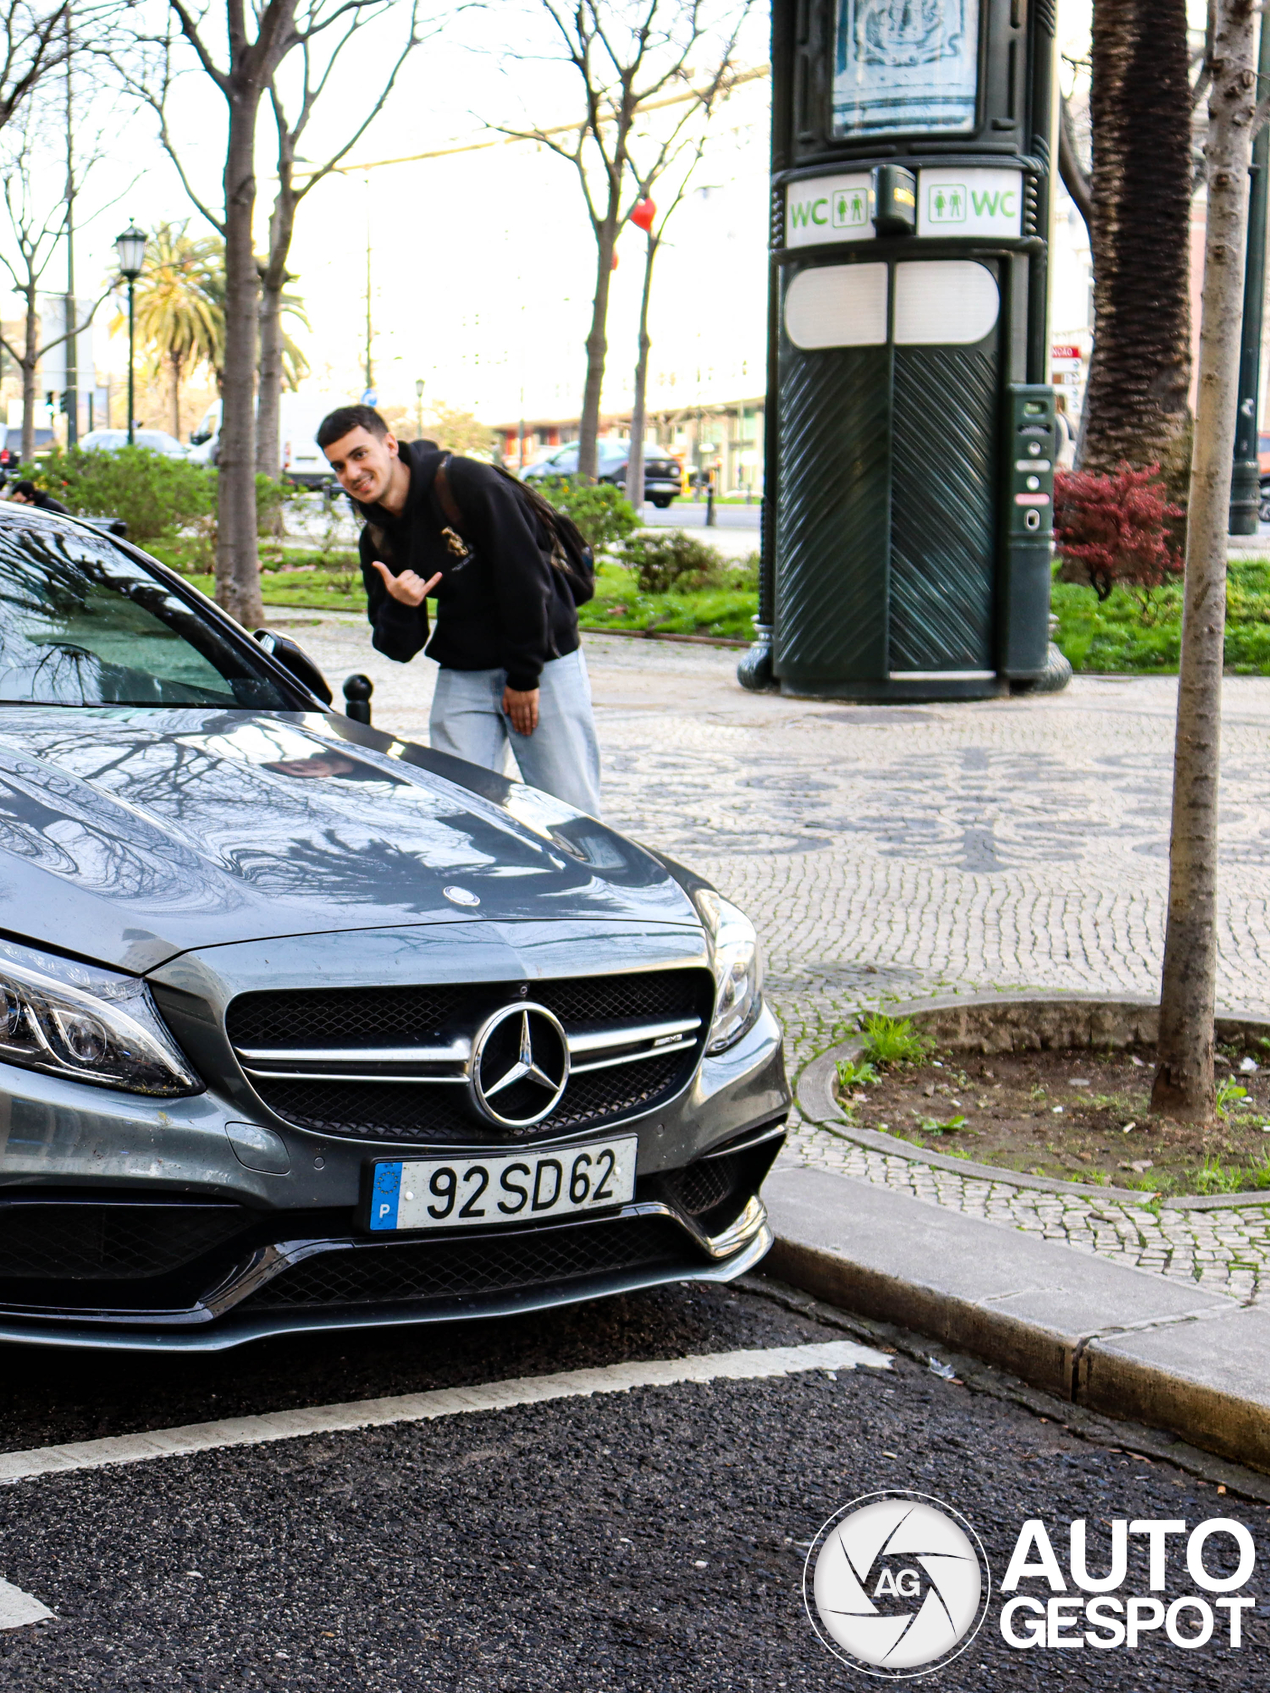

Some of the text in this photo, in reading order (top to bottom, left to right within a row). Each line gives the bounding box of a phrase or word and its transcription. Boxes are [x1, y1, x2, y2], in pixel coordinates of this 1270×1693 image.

[790, 198, 829, 229] WC
[971, 190, 1016, 218] WC
[379, 1203, 391, 1218] P
